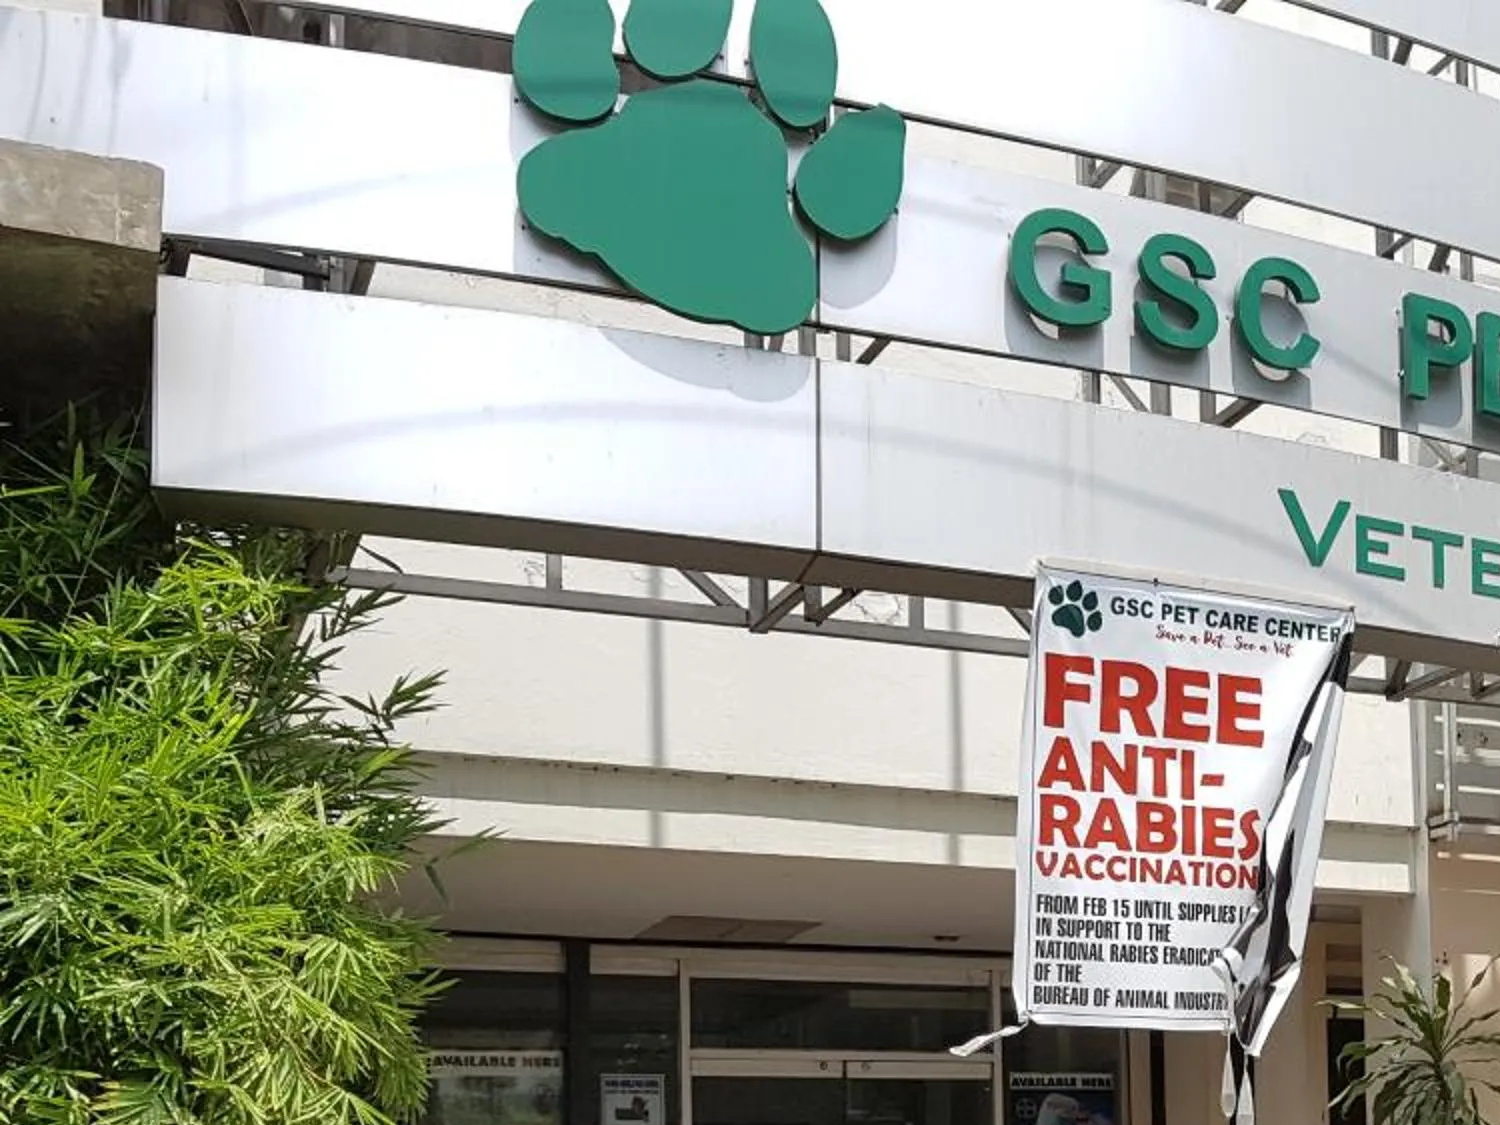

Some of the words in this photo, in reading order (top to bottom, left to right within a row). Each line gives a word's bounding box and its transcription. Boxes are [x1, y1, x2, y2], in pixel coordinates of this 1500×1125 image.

[1008, 208, 1321, 371] GSC
[1111, 596, 1154, 618] GSC
[1161, 603, 1199, 625] PET
[1205, 609, 1259, 633] CARE
[1265, 618, 1341, 643] CENTER
[1155, 624, 1186, 643] Save
[1234, 635, 1256, 652] See
[1043, 652, 1265, 748] FREE
[1037, 736, 1226, 800] ANTI-
[1039, 793, 1262, 861] RABIES
[1036, 851, 1258, 891] VACCINATION
[1036, 894, 1079, 916] FROM
[1083, 897, 1107, 918] FEB
[1113, 899, 1130, 918] 15
[1134, 900, 1173, 921] UNTIL
[1178, 902, 1237, 924] SUPPLIES
[1036, 918, 1051, 937] IN
[1057, 919, 1121, 941] SUPPORT
[1126, 921, 1143, 942] TO
[1149, 923, 1171, 943] THE
[1035, 941, 1105, 963] NATIONAL
[1110, 945, 1158, 965] RABIES
[1034, 964, 1051, 982] OF
[1057, 965, 1082, 984] THE
[1033, 986, 1089, 1007] BUREAU
[1093, 988, 1110, 1008] OF
[1115, 989, 1169, 1010] ANIMAL
[432, 1056, 517, 1068] AVAILABLE
[1012, 1077, 1077, 1087] AVAILABLE
